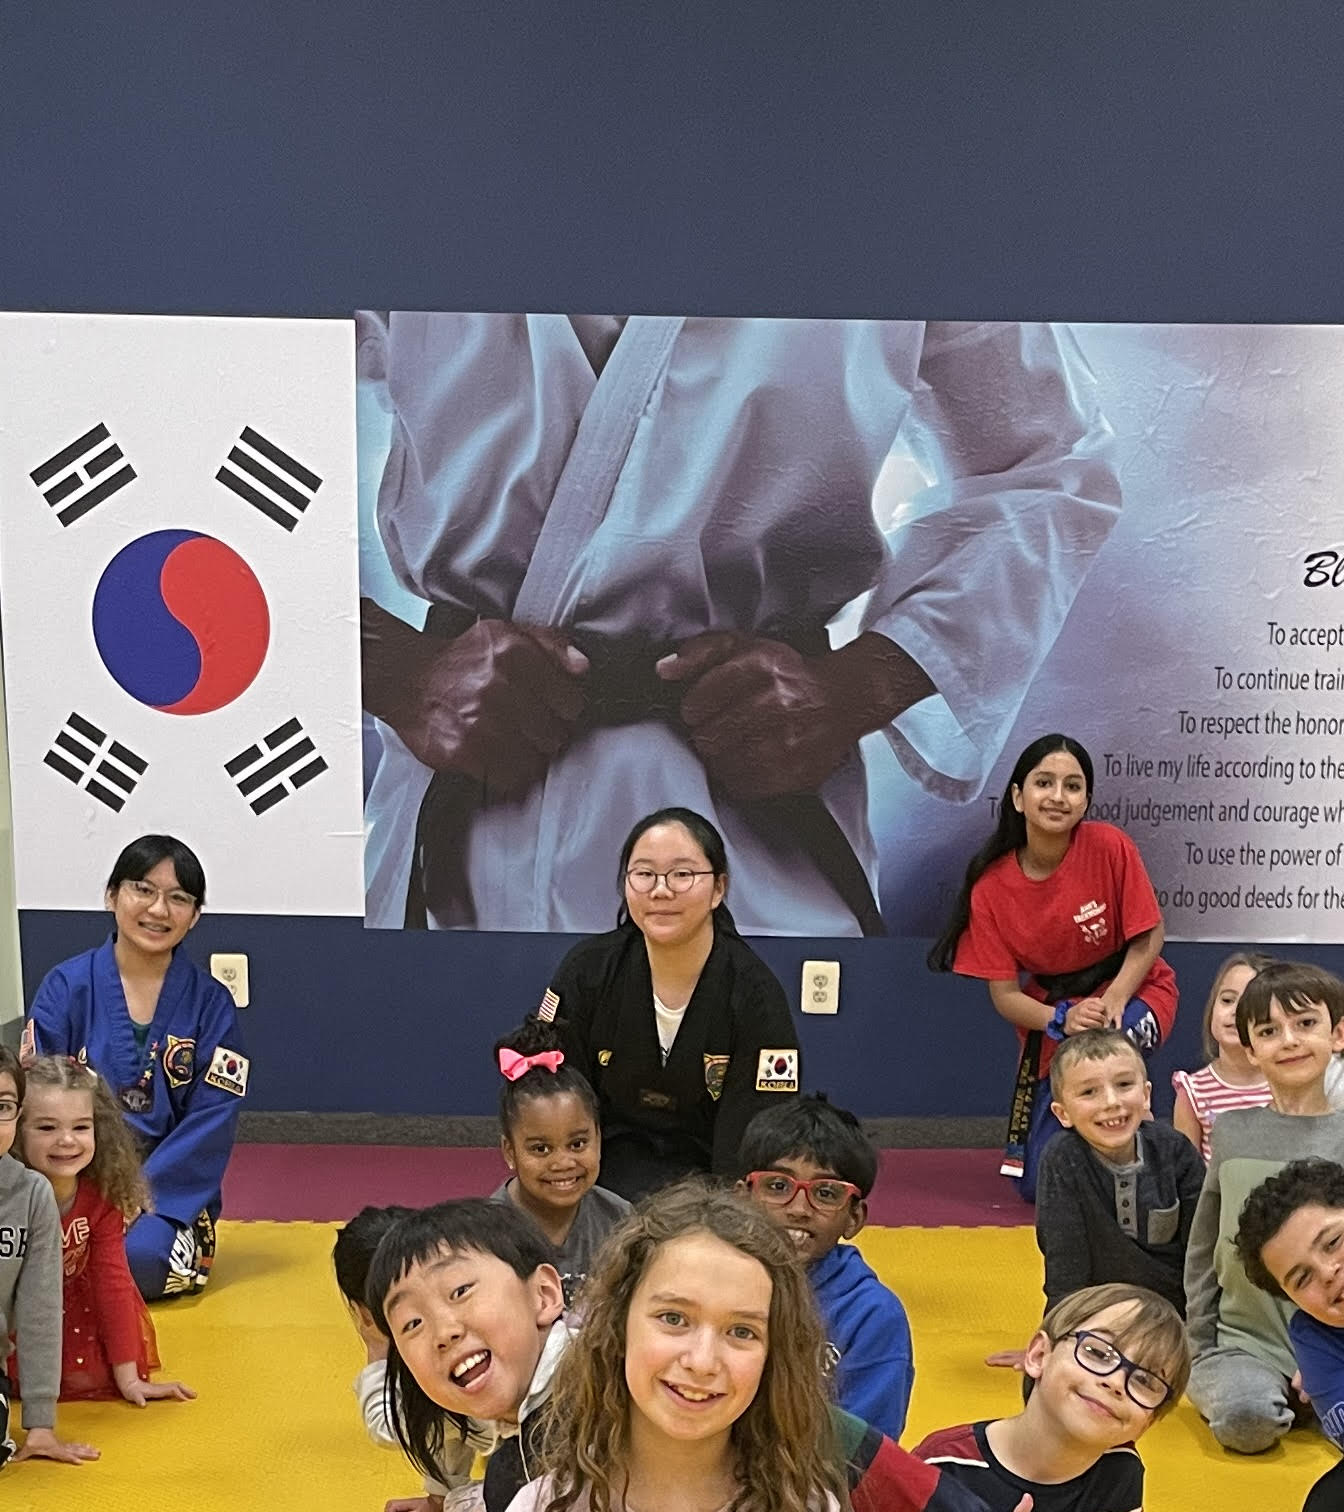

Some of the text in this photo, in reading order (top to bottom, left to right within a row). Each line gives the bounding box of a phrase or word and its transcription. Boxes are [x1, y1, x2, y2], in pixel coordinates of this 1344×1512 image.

[1267, 622, 1286, 646] To
[1289, 625, 1344, 652] accept
[1214, 666, 1233, 690] To
[1237, 667, 1310, 691] continue
[1178, 710, 1196, 735] To
[1200, 713, 1260, 740] respect
[1265, 711, 1292, 736] the
[1103, 753, 1122, 778] To
[1126, 754, 1154, 778] live
[1158, 759, 1183, 783] my
[1187, 754, 1210, 778] life
[1214, 755, 1294, 785] according
[1299, 759, 1316, 780] to
[1089, 797, 1121, 821] ood
[1123, 797, 1214, 827] judgement
[1218, 799, 1249, 822] and
[1253, 802, 1320, 828] courage
[1184, 841, 1204, 865] To
[1207, 847, 1235, 866] use
[1239, 842, 1266, 867] the
[1269, 848, 1322, 872] power
[1325, 843, 1344, 868] of
[1173, 884, 1195, 908] do
[1198, 885, 1242, 914] good
[1244, 885, 1293, 909] deeds
[1297, 886, 1320, 910] for
